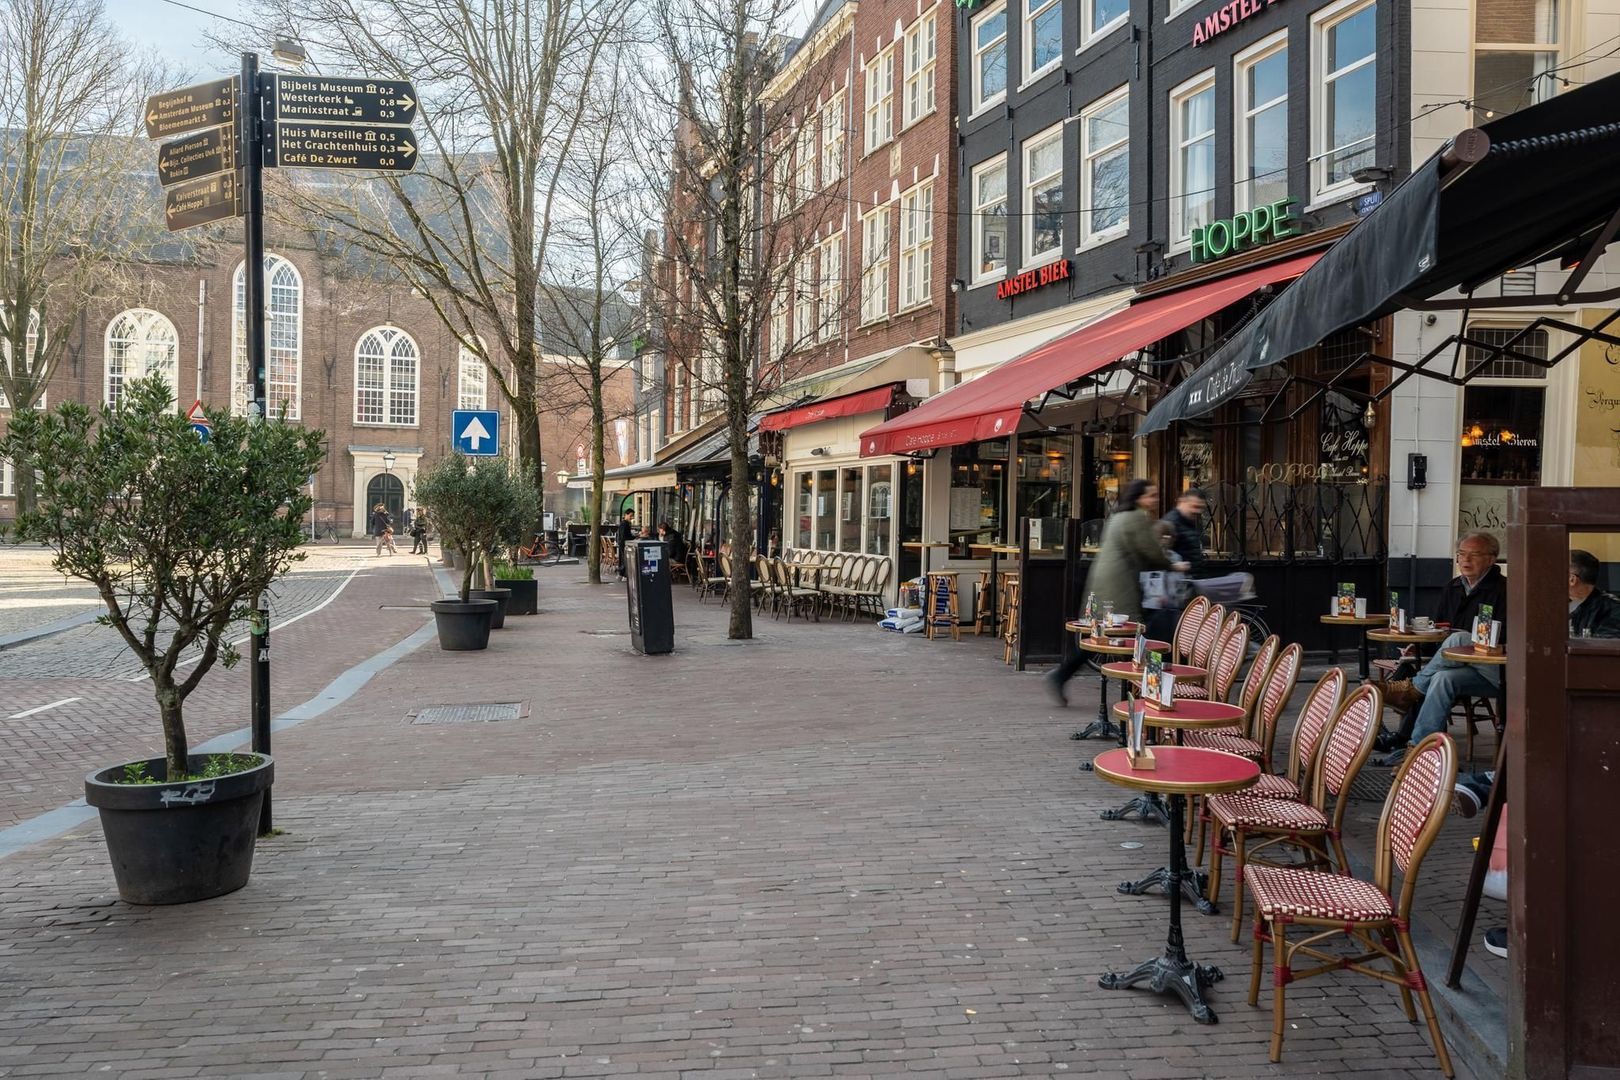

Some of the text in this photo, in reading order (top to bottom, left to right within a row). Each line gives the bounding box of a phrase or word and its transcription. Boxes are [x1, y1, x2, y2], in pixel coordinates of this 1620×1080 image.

[282, 81, 394, 95] Bijbels Museum 0,2
[159, 95, 187, 109] Begijnhof
[282, 93, 395, 106] Westerkerk 0,8
[160, 107, 190, 119] Amsterdam
[191, 101, 214, 112] Museum
[282, 104, 395, 118] Marnixstraat 0,9
[160, 115, 201, 131] Bloemenmarkt
[282, 128, 396, 141] Huis Marseille 0,5
[282, 140, 396, 153] Het Grachtenhuis 0,3
[284, 153, 395, 166] Café De Zwart 0,0
[176, 185, 210, 202] Kalverstraat
[188, 199, 203, 210] Hoppe
[1190, 196, 1297, 263] HOPPE
[996, 258, 1069, 300] AMSTEL BIER
